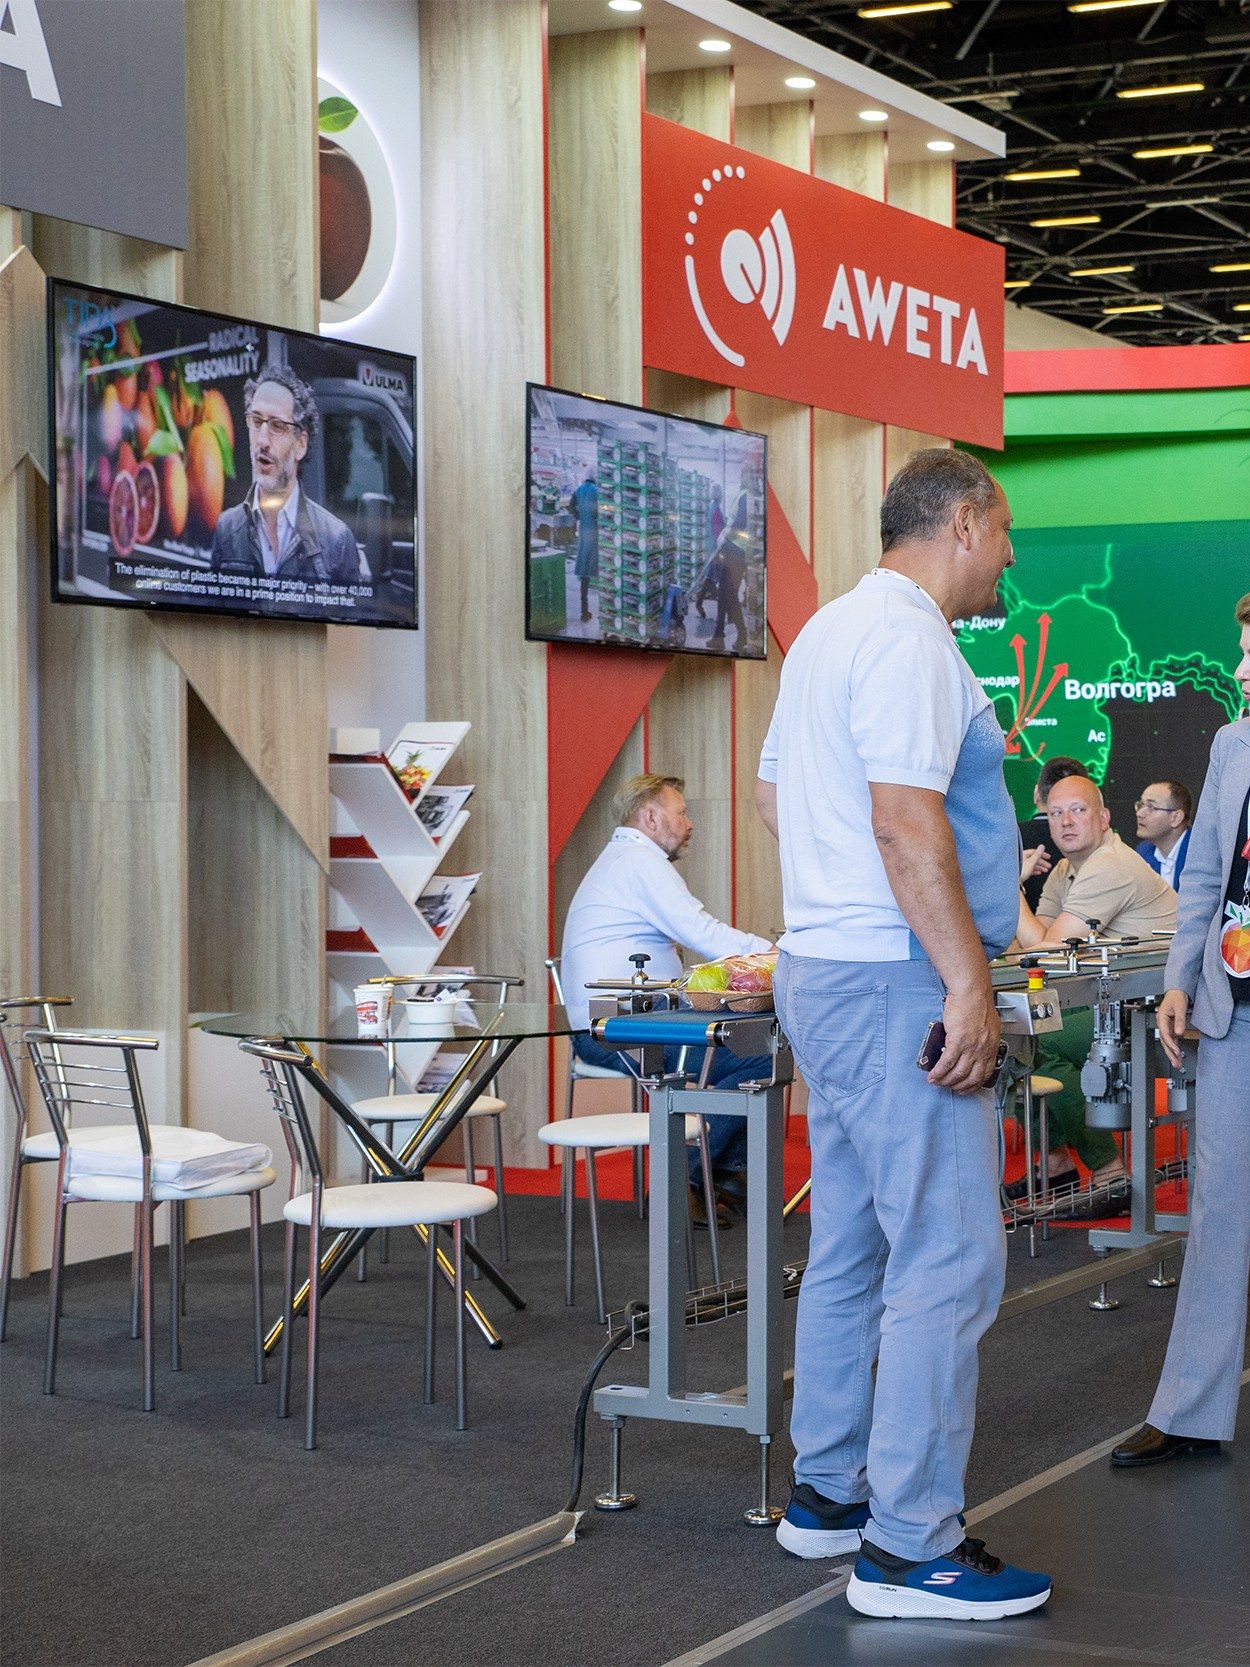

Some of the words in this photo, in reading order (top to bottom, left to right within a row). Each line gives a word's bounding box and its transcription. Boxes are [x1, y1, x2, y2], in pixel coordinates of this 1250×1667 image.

[822, 263, 989, 376] AWETA
[208, 325, 259, 353] RADICAL
[184, 350, 260, 384] SEASONALITY
[375, 374, 405, 391] ULMA
[114, 562, 133, 575] The
[134, 564, 179, 579] elimination
[180, 569, 190, 580] of
[190, 570, 218, 583] plastic
[218, 571, 251, 586] became
[252, 577, 258, 587] a
[259, 577, 280, 590] major
[281, 578, 308, 593] priority
[315, 582, 330, 593] with
[330, 584, 349, 595] over
[348, 584, 374, 598] 40,000
[135, 578, 163, 590] online
[163, 580, 207, 595] customers
[207, 585, 221, 596] we
[221, 586, 235, 597] are
[236, 585, 245, 597] in
[245, 588, 252, 598] a
[252, 588, 275, 601] prime
[275, 590, 306, 603] position
[305, 593, 314, 604] to
[314, 593, 340, 607] impact
[1064, 678, 1177, 703] Волгогра
